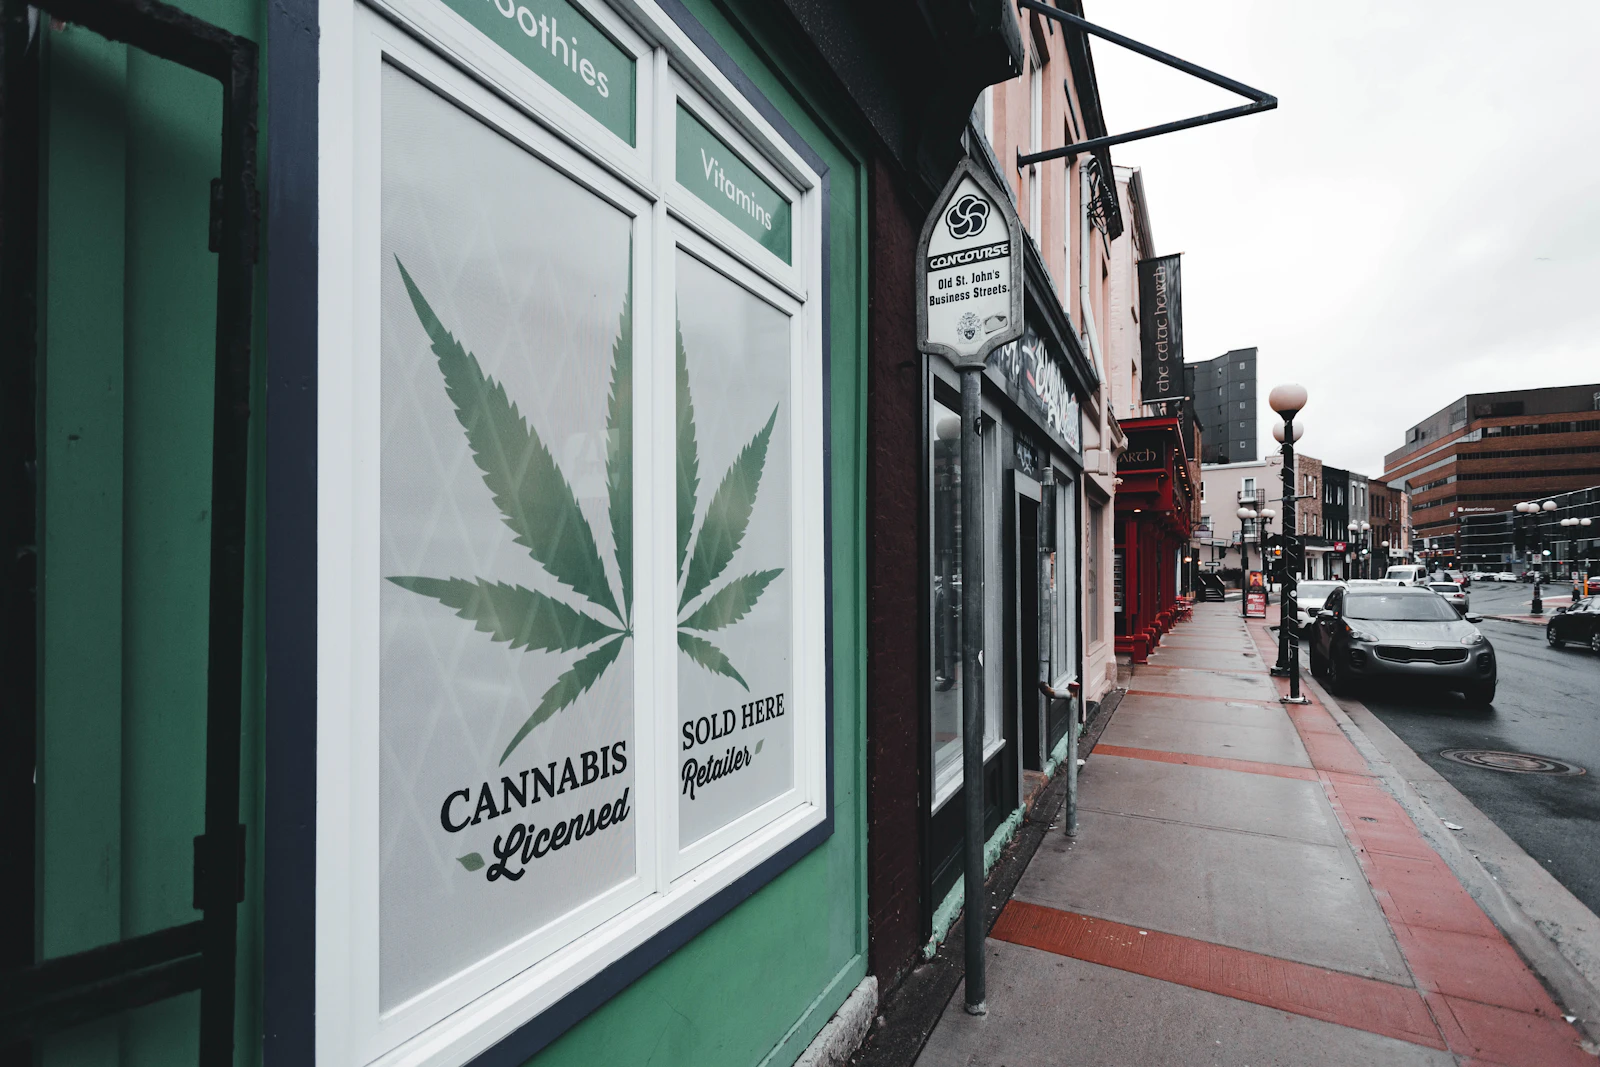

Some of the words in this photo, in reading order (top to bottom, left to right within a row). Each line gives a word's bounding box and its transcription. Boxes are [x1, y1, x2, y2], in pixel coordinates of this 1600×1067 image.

[486, 0, 609, 98] oothies
[701, 148, 772, 231] Vitamins
[929, 290, 970, 306] Business
[973, 285, 1010, 299] Streets.
[930, 244, 1008, 268] CONCOURSE
[938, 277, 953, 290] Old
[956, 274, 968, 287] St.
[971, 270, 1000, 283] John's
[440, 740, 627, 833] CANNABIS
[682, 709, 736, 750] SOLD
[741, 693, 785, 730] HERE
[486, 787, 630, 882] Licensed
[682, 745, 752, 800] Retailer
